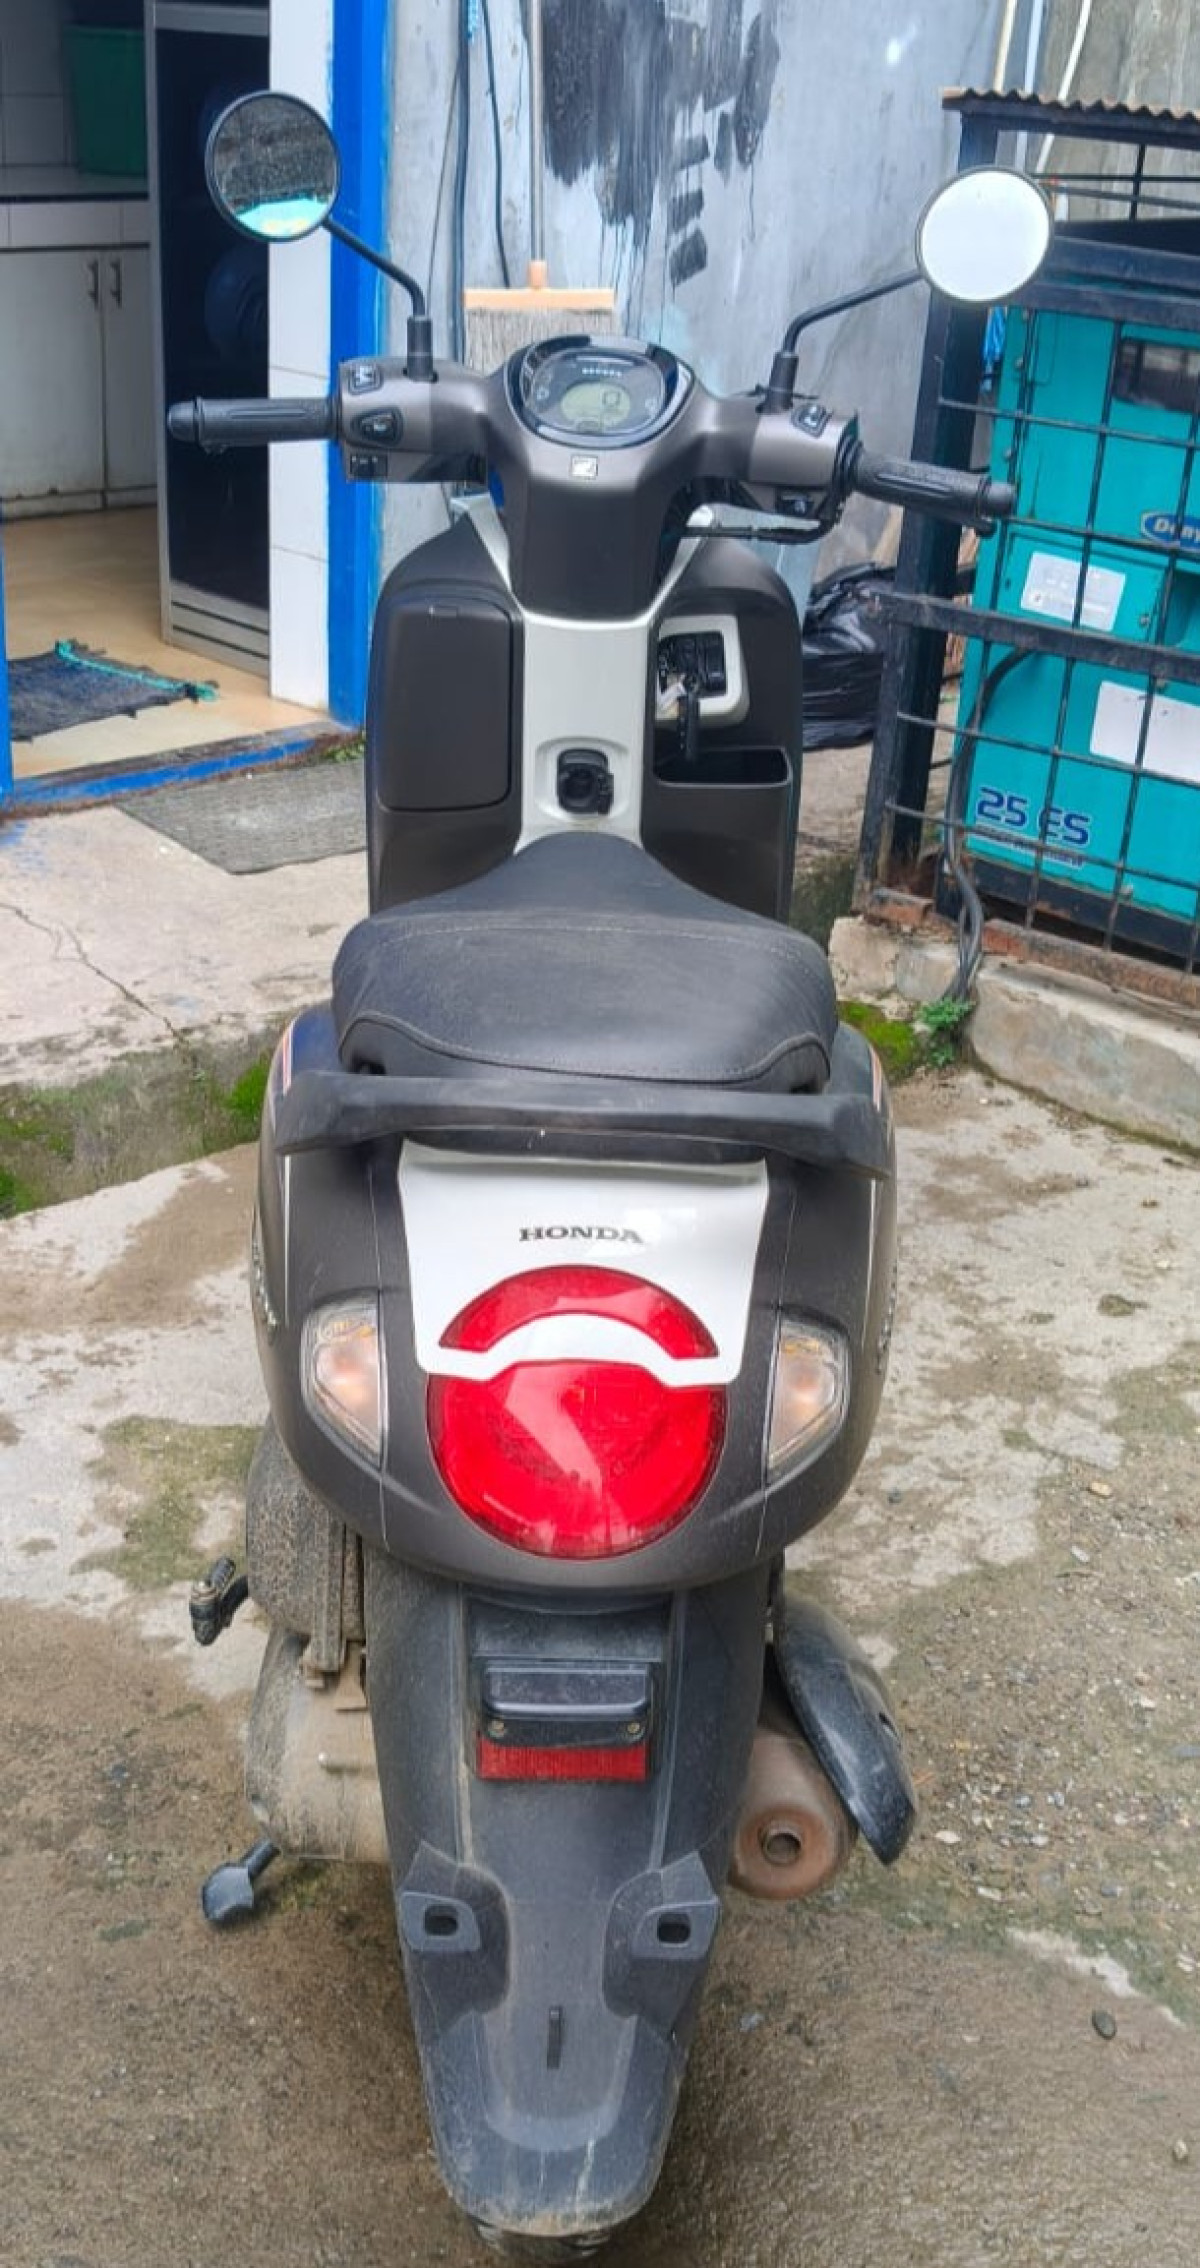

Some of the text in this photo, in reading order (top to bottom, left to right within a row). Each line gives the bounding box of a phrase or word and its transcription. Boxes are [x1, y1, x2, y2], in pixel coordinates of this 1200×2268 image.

[977, 786, 1091, 845] 25 ES
[518, 1225, 645, 1244] HONDA
